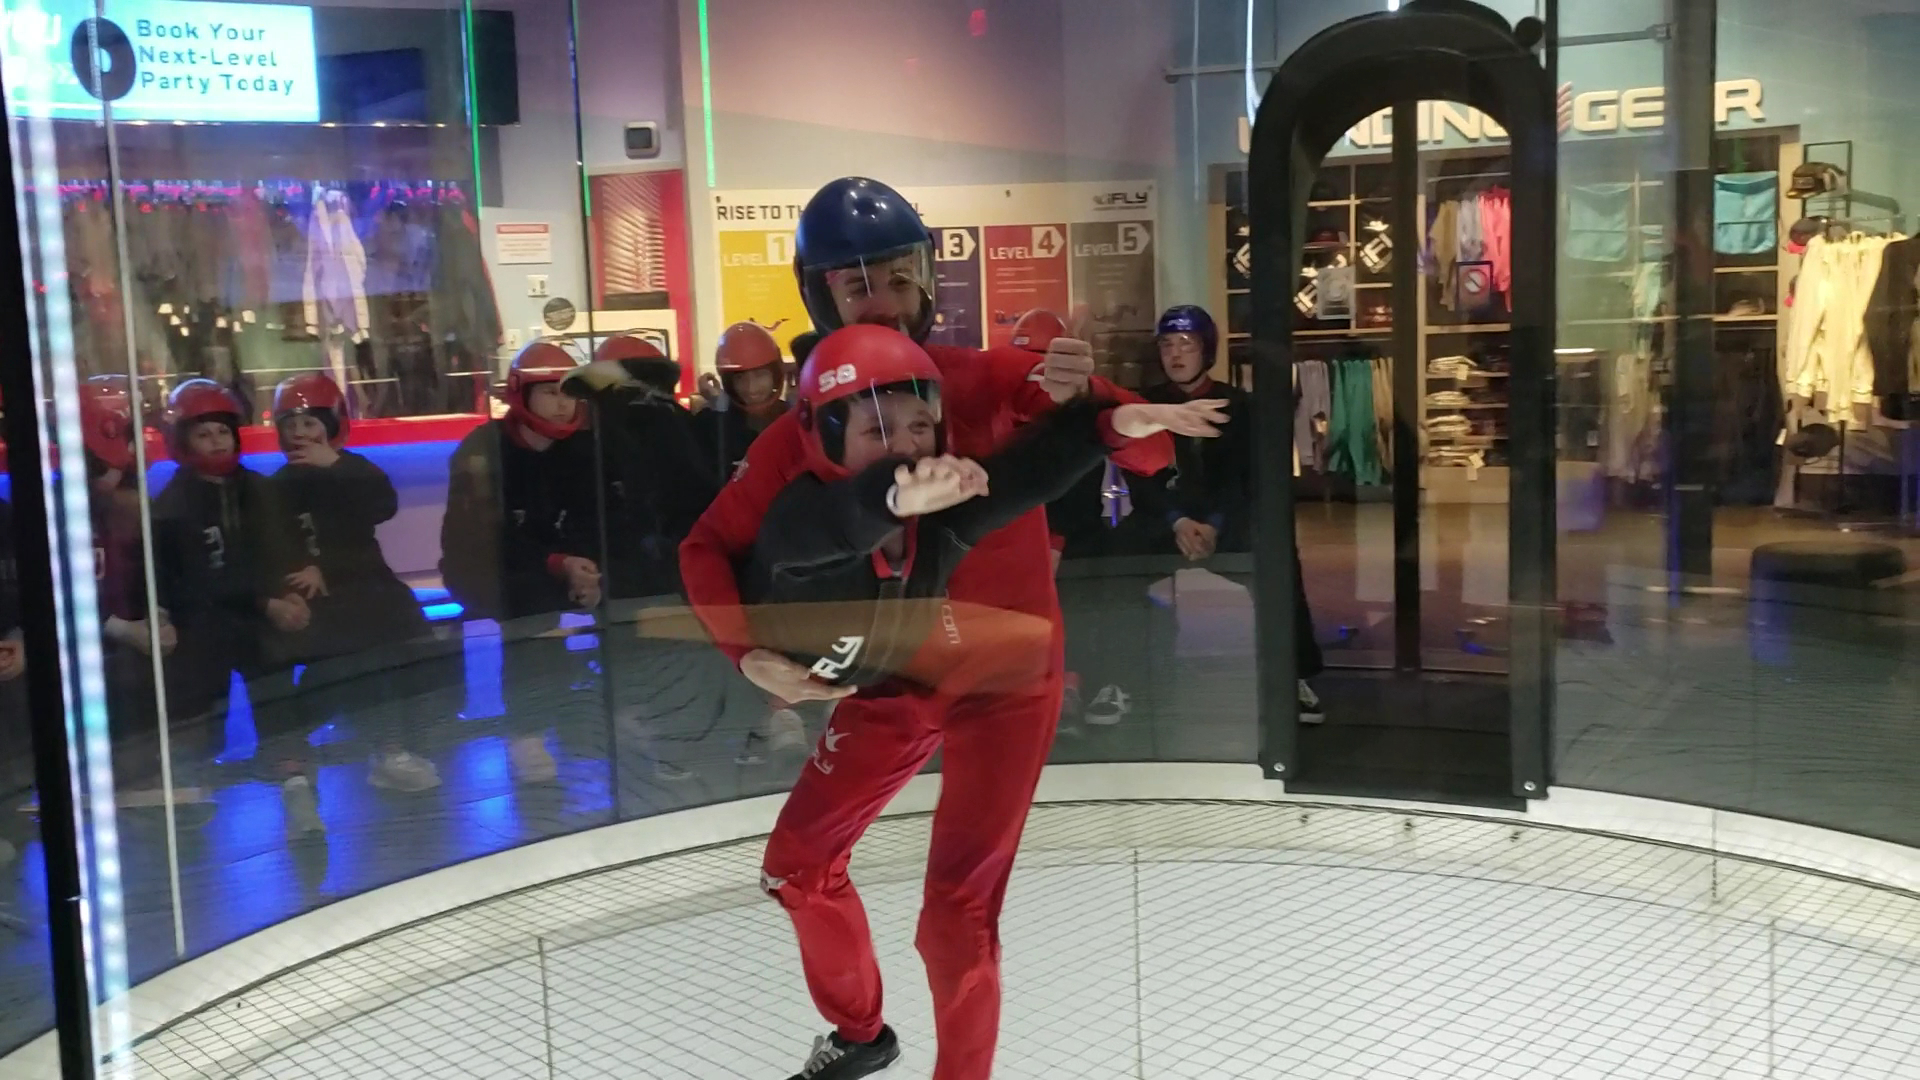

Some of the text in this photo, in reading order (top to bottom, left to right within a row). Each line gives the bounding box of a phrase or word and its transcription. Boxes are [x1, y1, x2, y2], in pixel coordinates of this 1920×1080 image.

[136, 19, 266, 41] Book Your
[138, 45, 278, 67] Next-Level
[141, 72, 295, 96] Party Today
[1573, 78, 1766, 132] GER
[717, 205, 756, 220] RISE
[760, 206, 781, 220] TO
[723, 236, 786, 267] LEVEL 1
[950, 232, 964, 258] 3
[989, 230, 1055, 260] LEVEL 4
[1075, 226, 1138, 257] LEVEL 5
[812, 636, 865, 680] FLY
